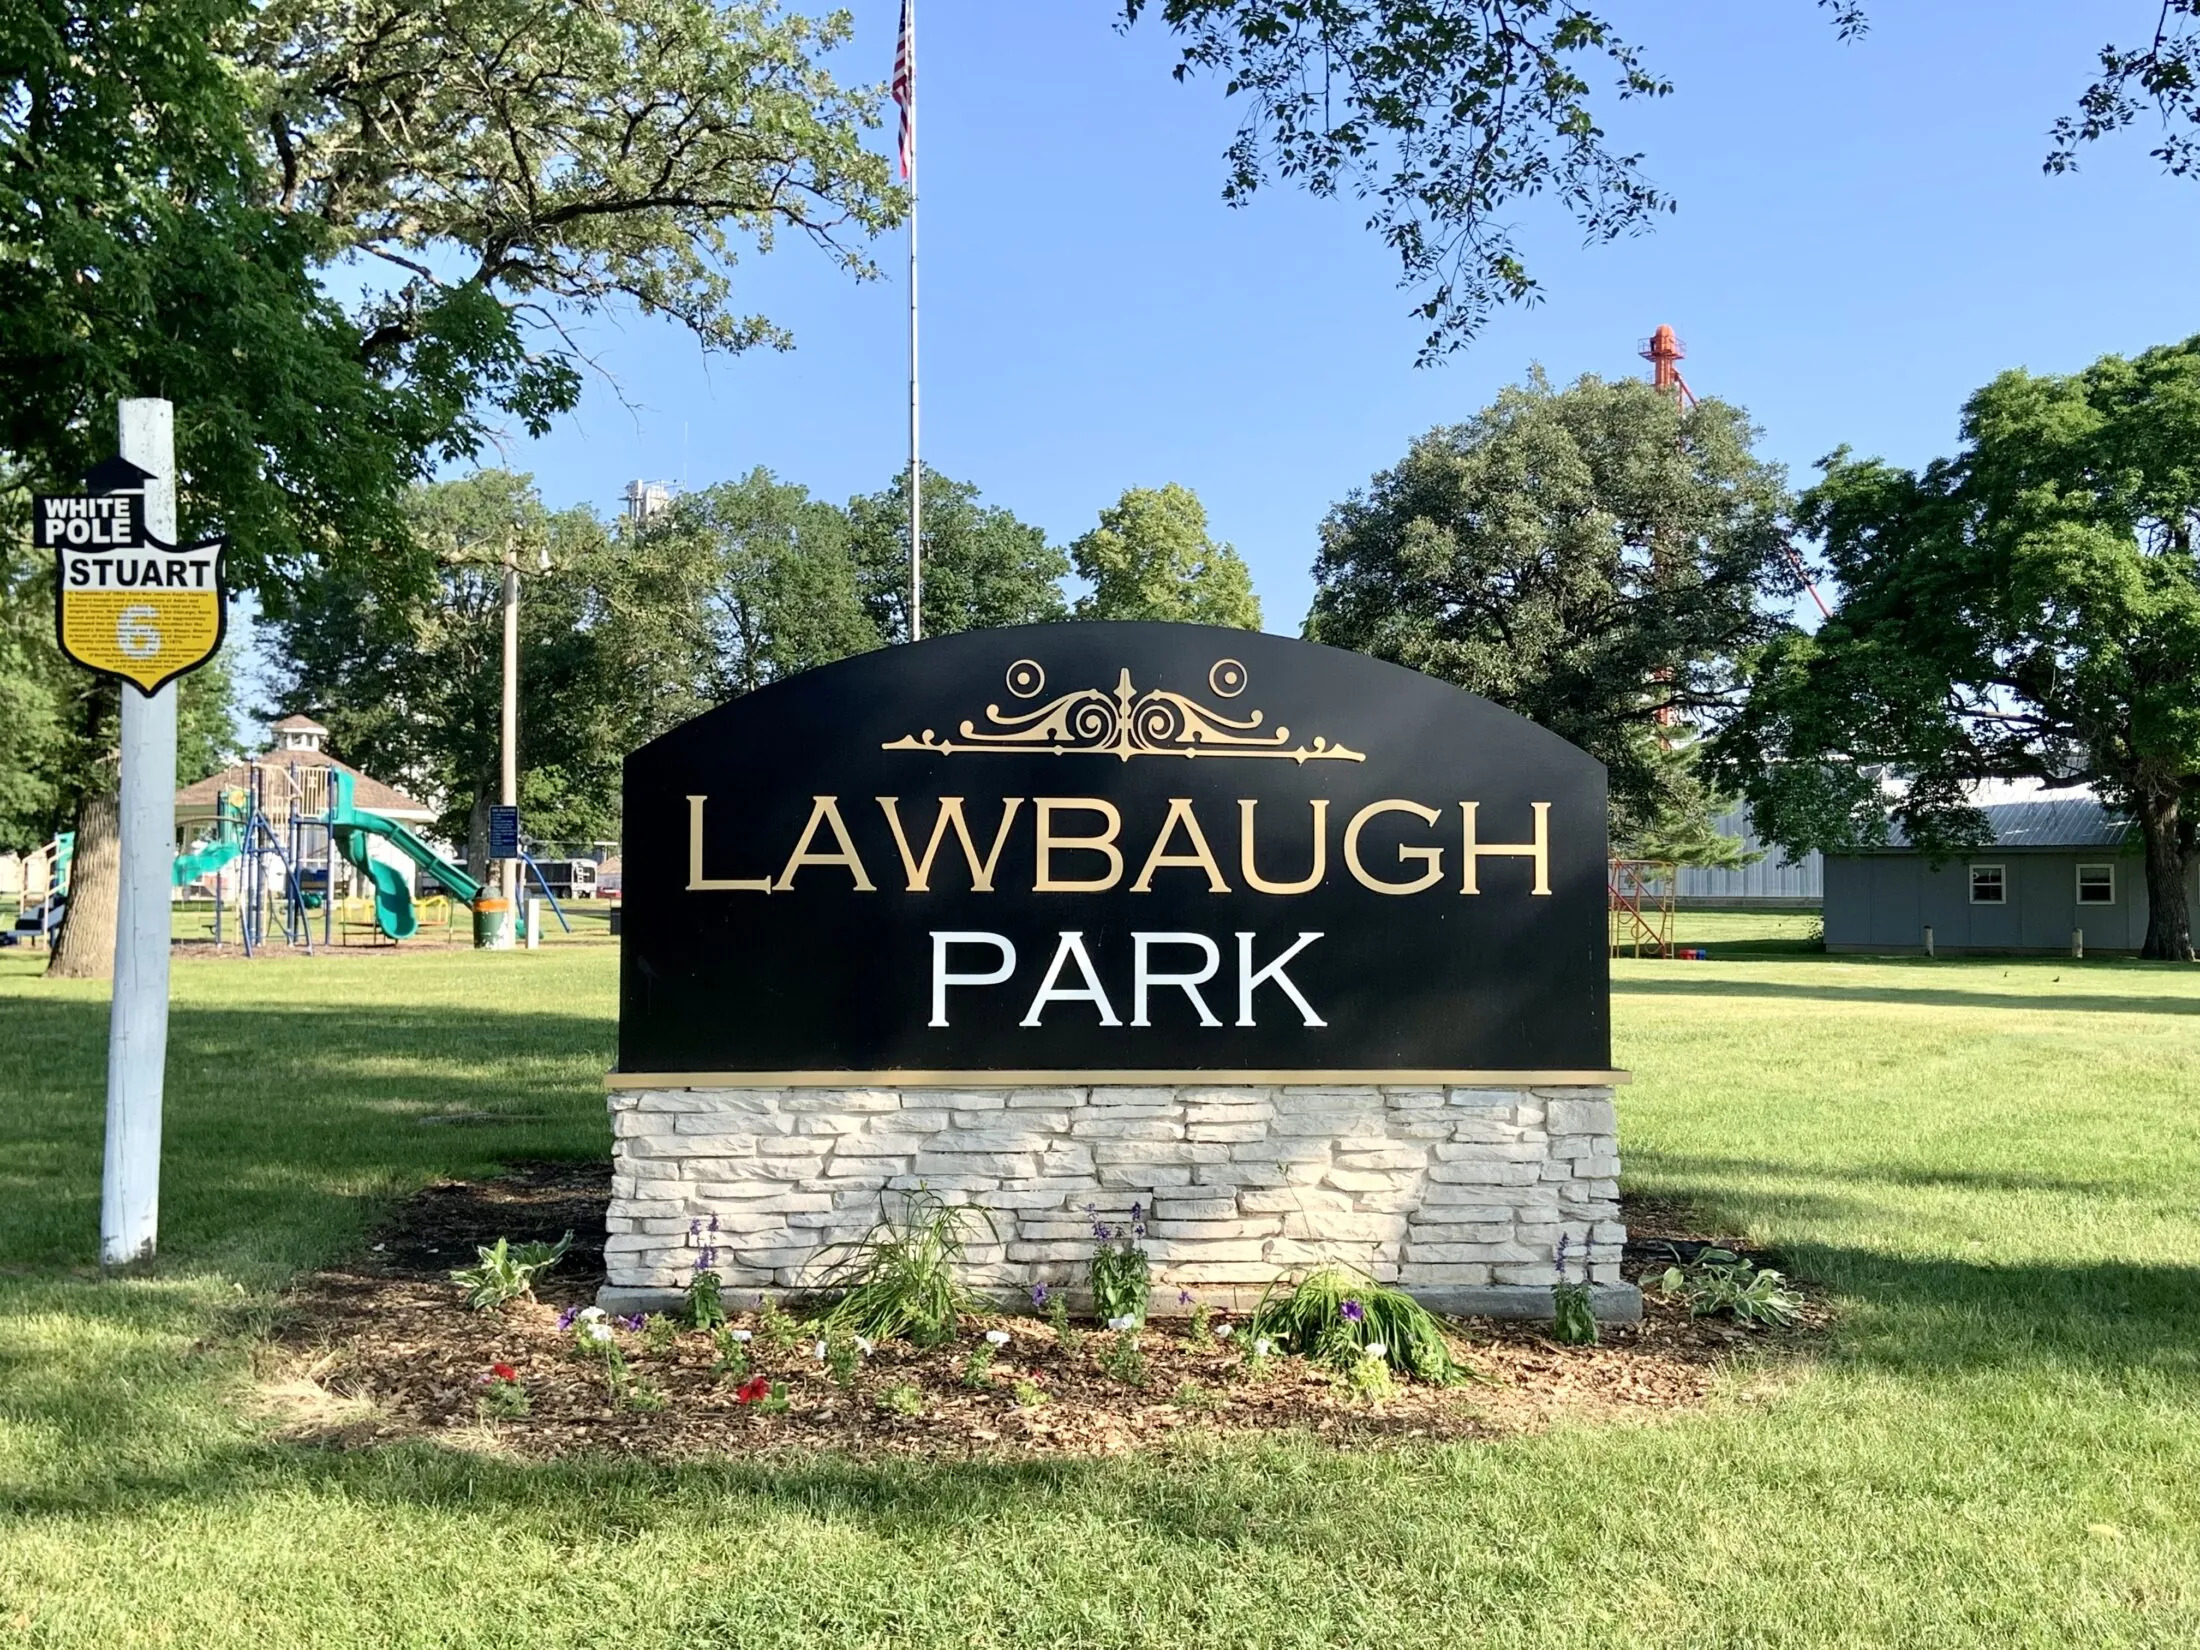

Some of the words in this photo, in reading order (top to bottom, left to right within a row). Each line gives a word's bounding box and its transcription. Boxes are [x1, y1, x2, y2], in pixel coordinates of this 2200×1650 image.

[45, 498, 131, 518] WHITE
[45, 518, 132, 544] POLE
[69, 558, 211, 587] STUART
[686, 796, 1552, 895] LAWBAUGH
[928, 932, 1328, 1026] PARK
